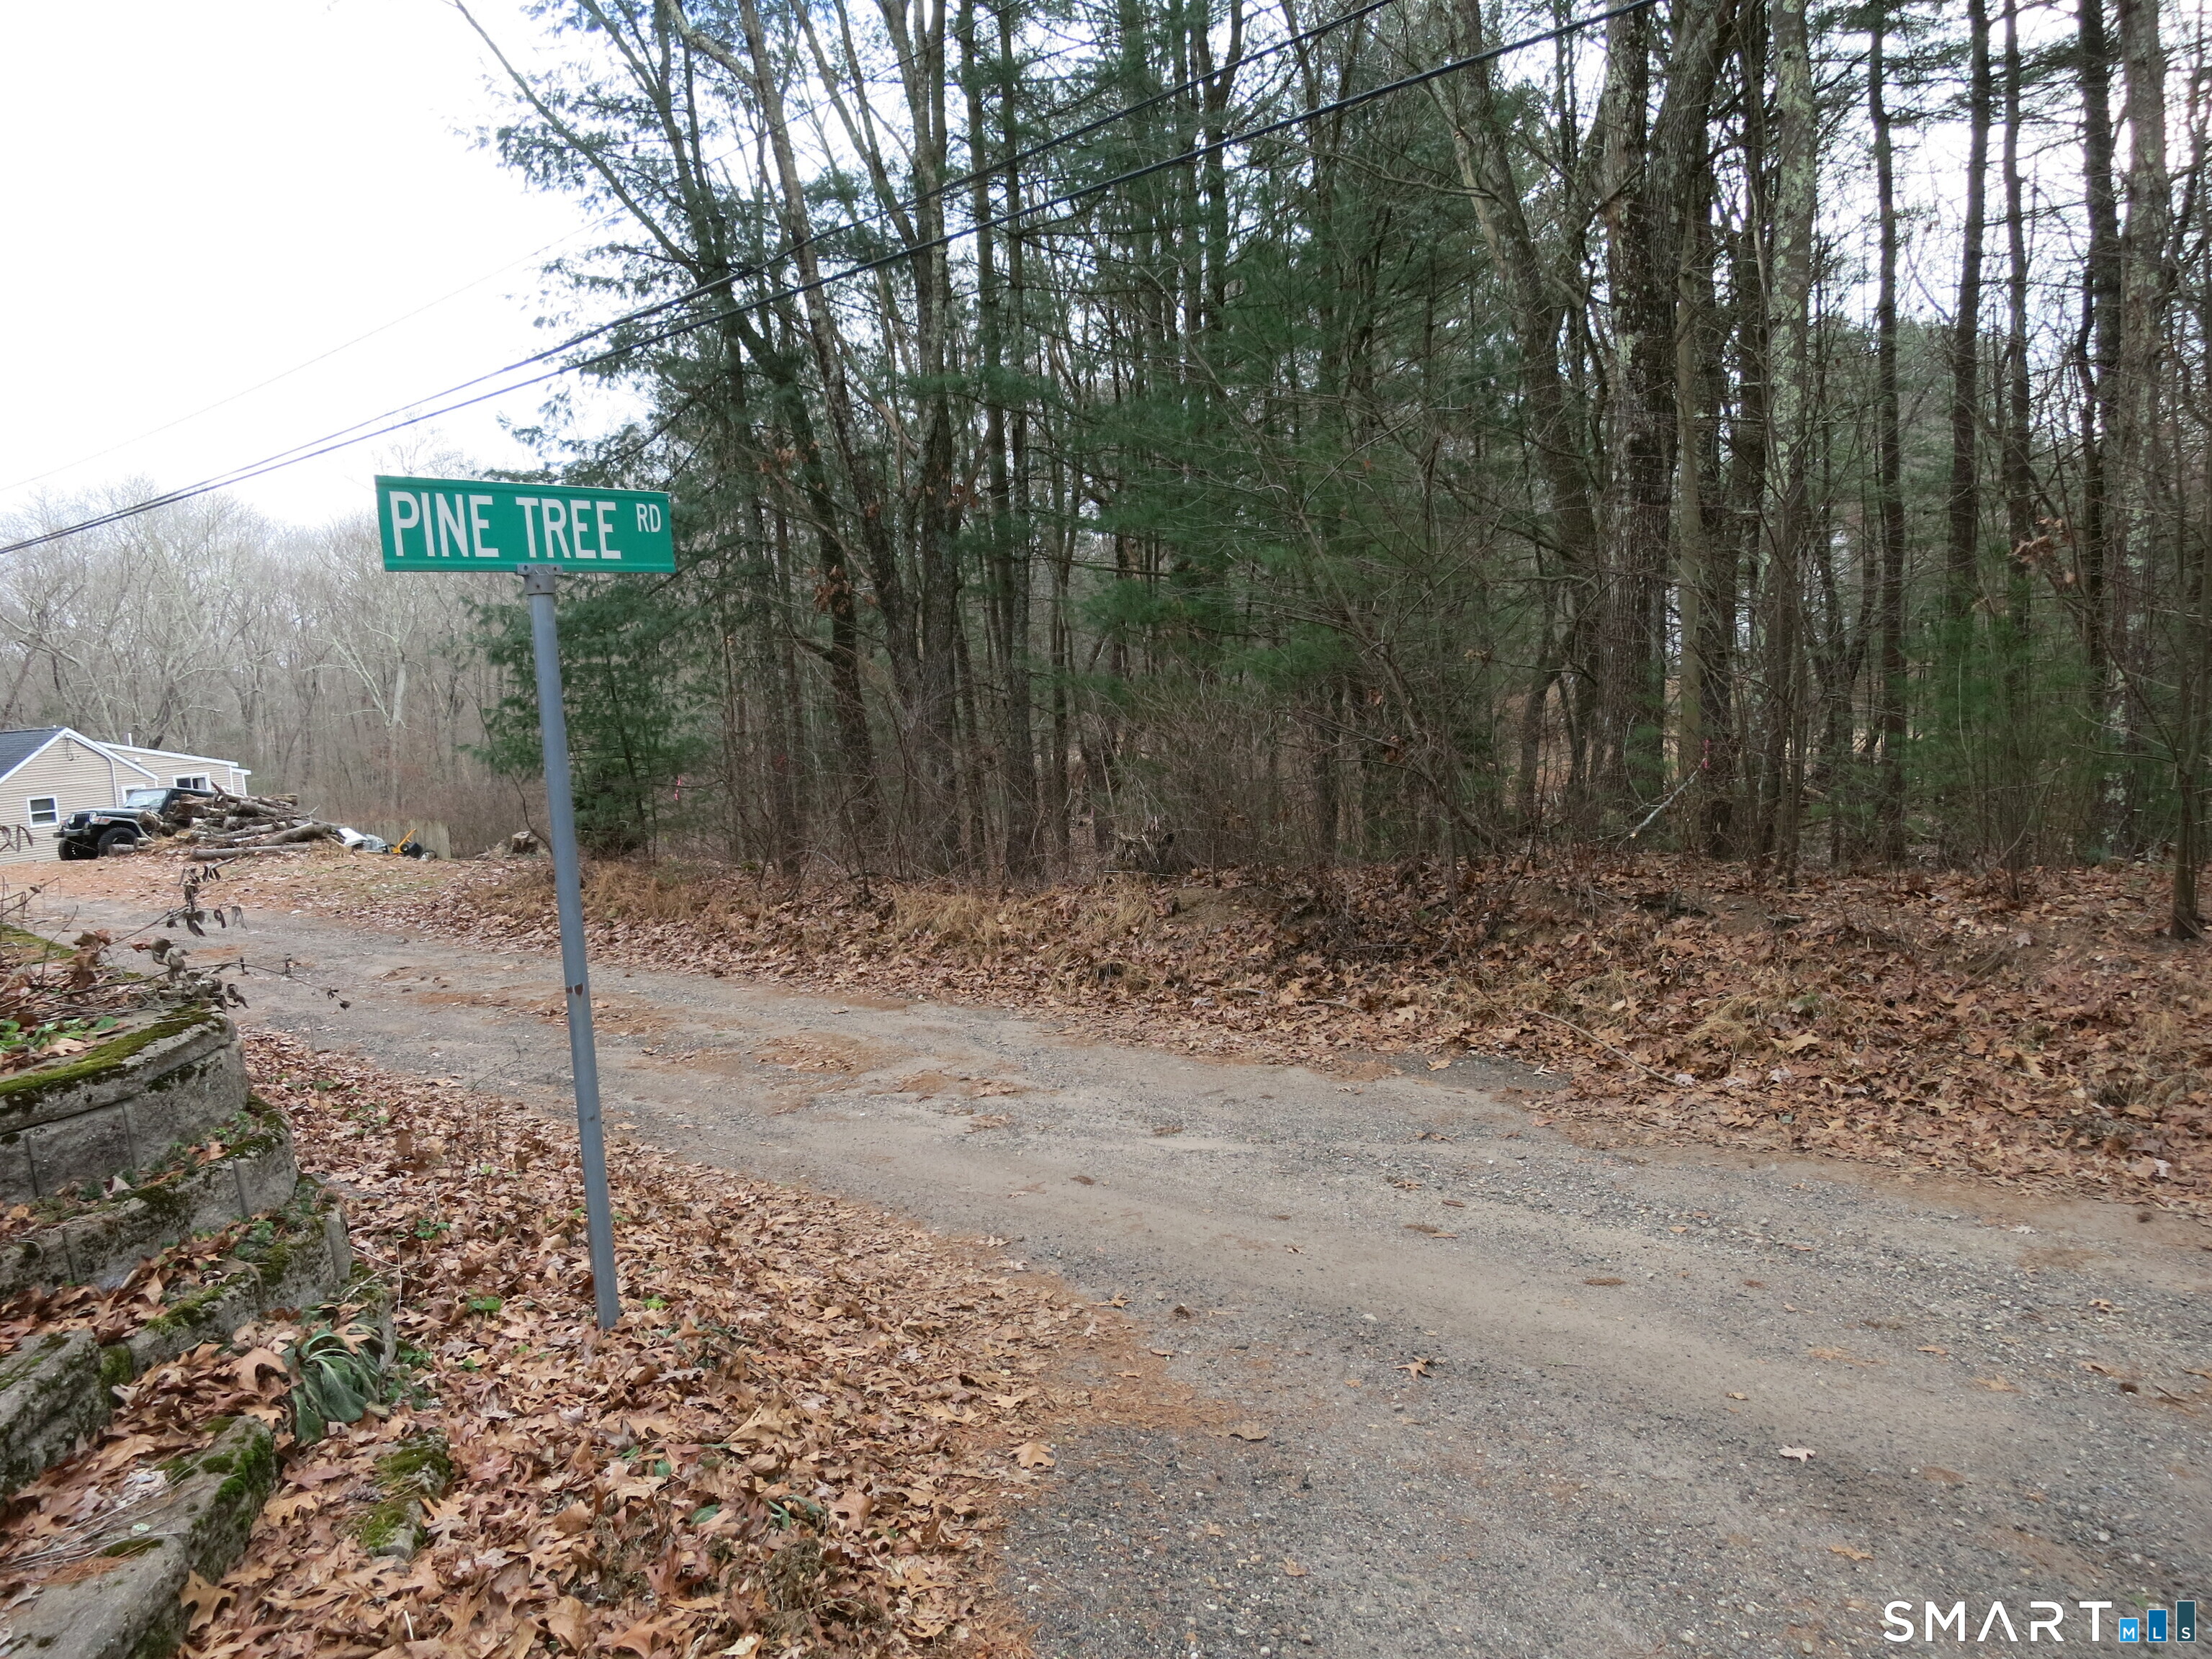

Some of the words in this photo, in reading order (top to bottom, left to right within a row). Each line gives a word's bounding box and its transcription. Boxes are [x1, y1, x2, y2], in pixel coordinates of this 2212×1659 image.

[389, 491, 499, 557] PINE
[516, 497, 621, 559] TREE
[637, 503, 661, 533] RD
